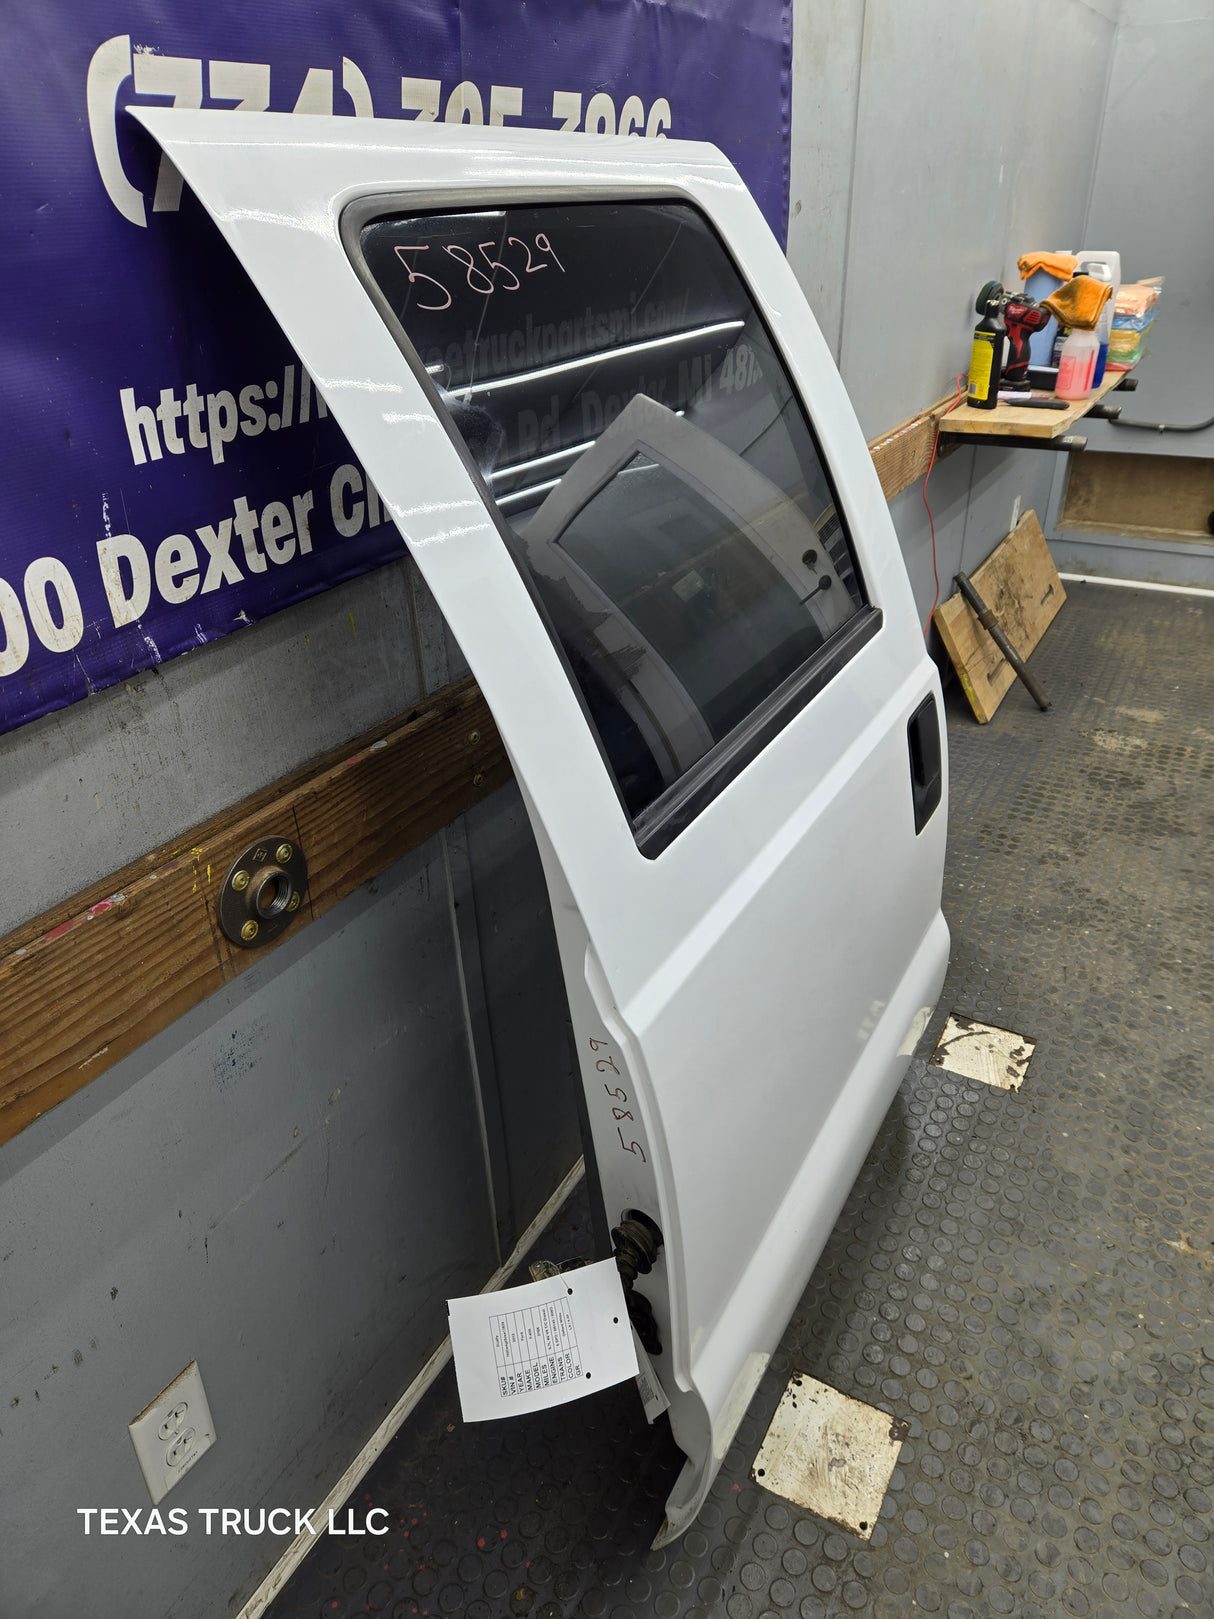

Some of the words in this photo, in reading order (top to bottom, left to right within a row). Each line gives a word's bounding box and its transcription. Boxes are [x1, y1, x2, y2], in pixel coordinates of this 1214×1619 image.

[393, 232, 567, 311] 58529
[119, 364, 328, 465] https://
[96, 489, 315, 629] Dexter
[589, 1037, 647, 1163] 58529
[533, 1361, 541, 1389] MODEL
[541, 1364, 550, 1387] MILES
[548, 1356, 558, 1384] ENGINE
[557, 1356, 566, 1381] TRANS
[565, 1352, 574, 1379] COLOR
[575, 1364, 582, 1376] GR
[500, 1376, 508, 1396] SKU#
[516, 1372, 524, 1392] YEAR
[525, 1369, 533, 1391] MAKE
